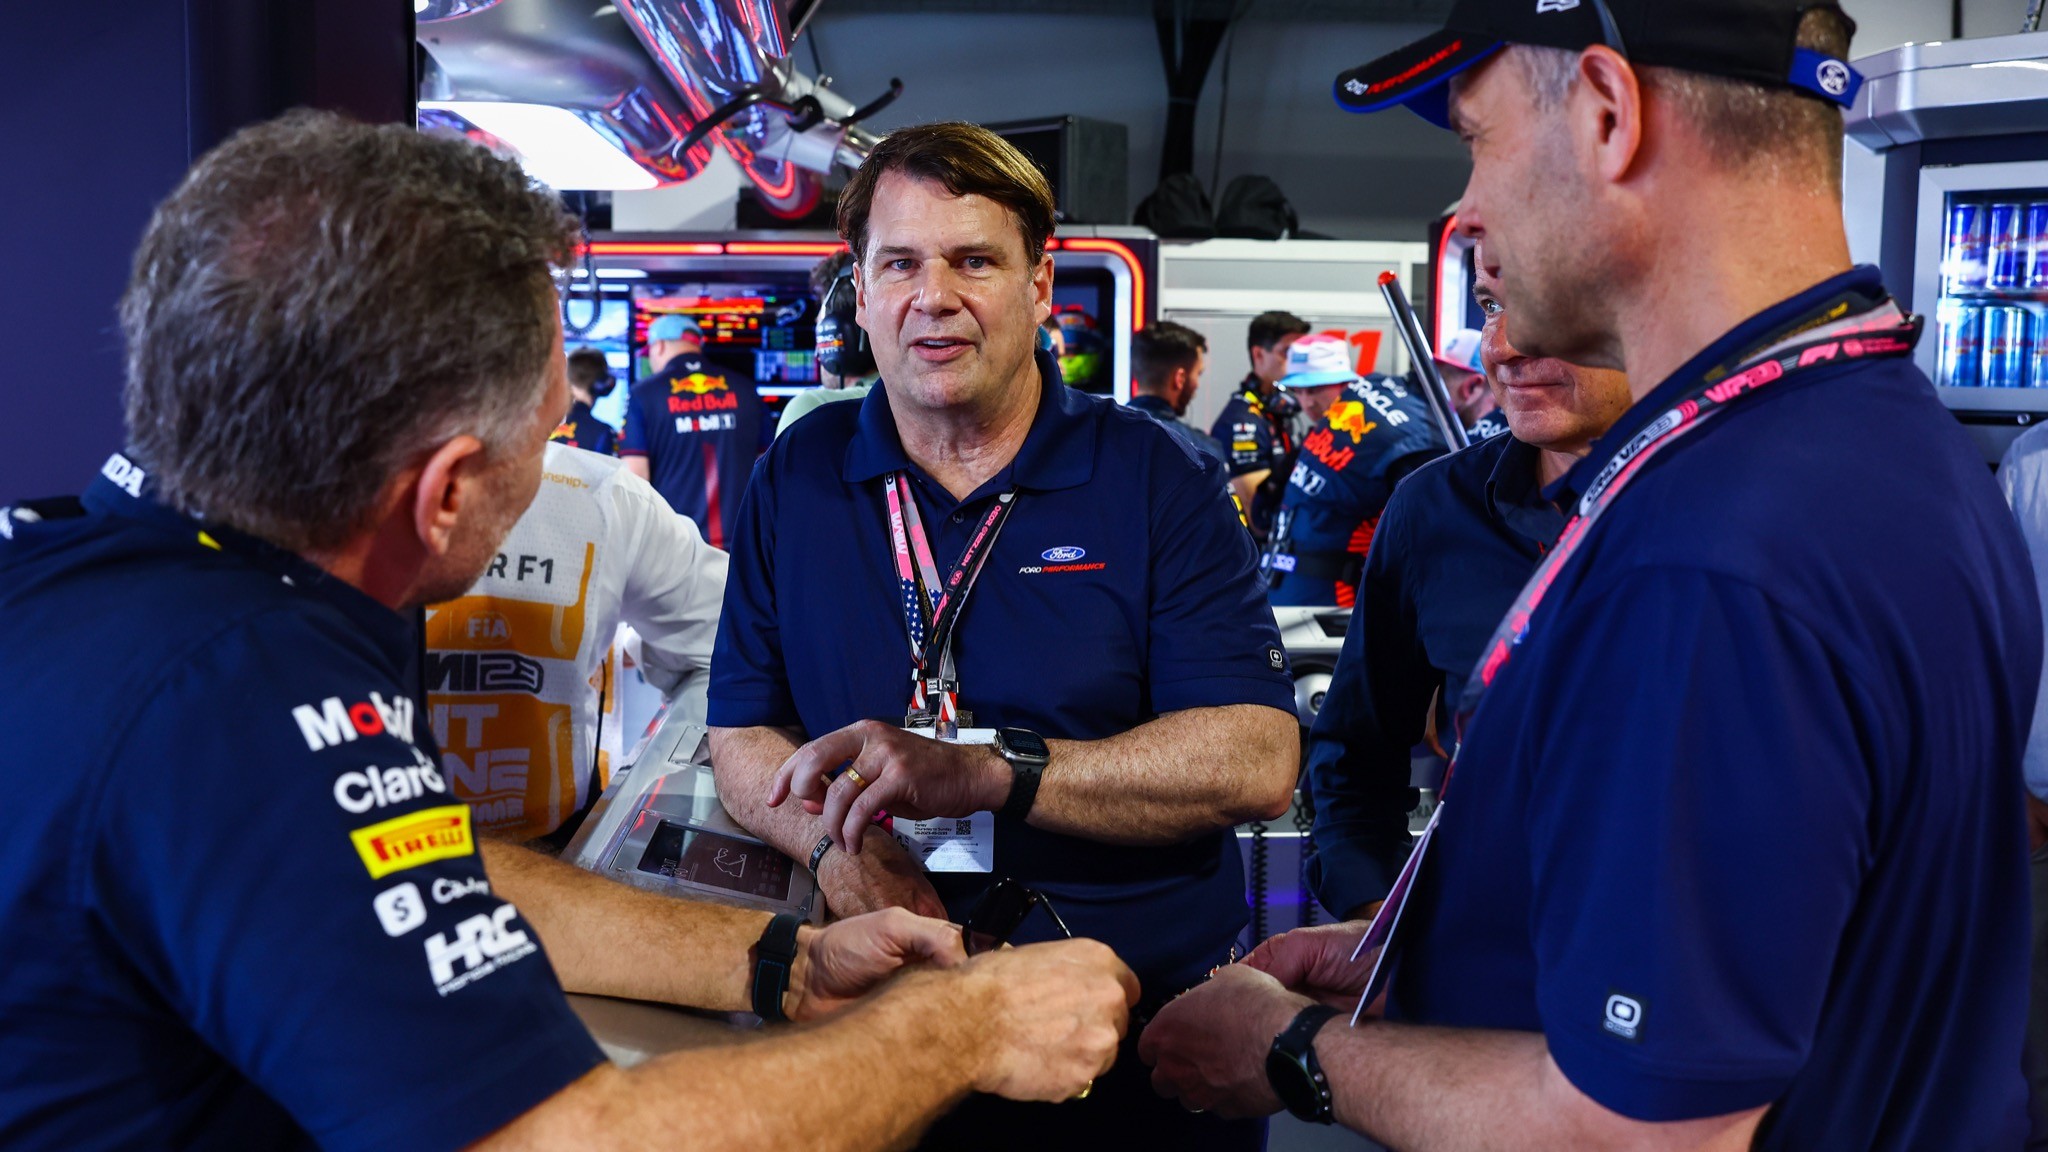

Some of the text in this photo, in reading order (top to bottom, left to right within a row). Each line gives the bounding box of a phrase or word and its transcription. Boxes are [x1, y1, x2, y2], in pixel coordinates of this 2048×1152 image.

[675, 414, 720, 433] Mobil
[517, 555, 554, 584] F1
[1018, 562, 1106, 575] FORD PERFORMANCE
[292, 690, 415, 752] Mobil
[428, 703, 499, 749] IT
[333, 764, 447, 814] Claro
[442, 748, 530, 795] NE
[370, 816, 465, 862] PIRELLI
[424, 902, 530, 986] HRC
